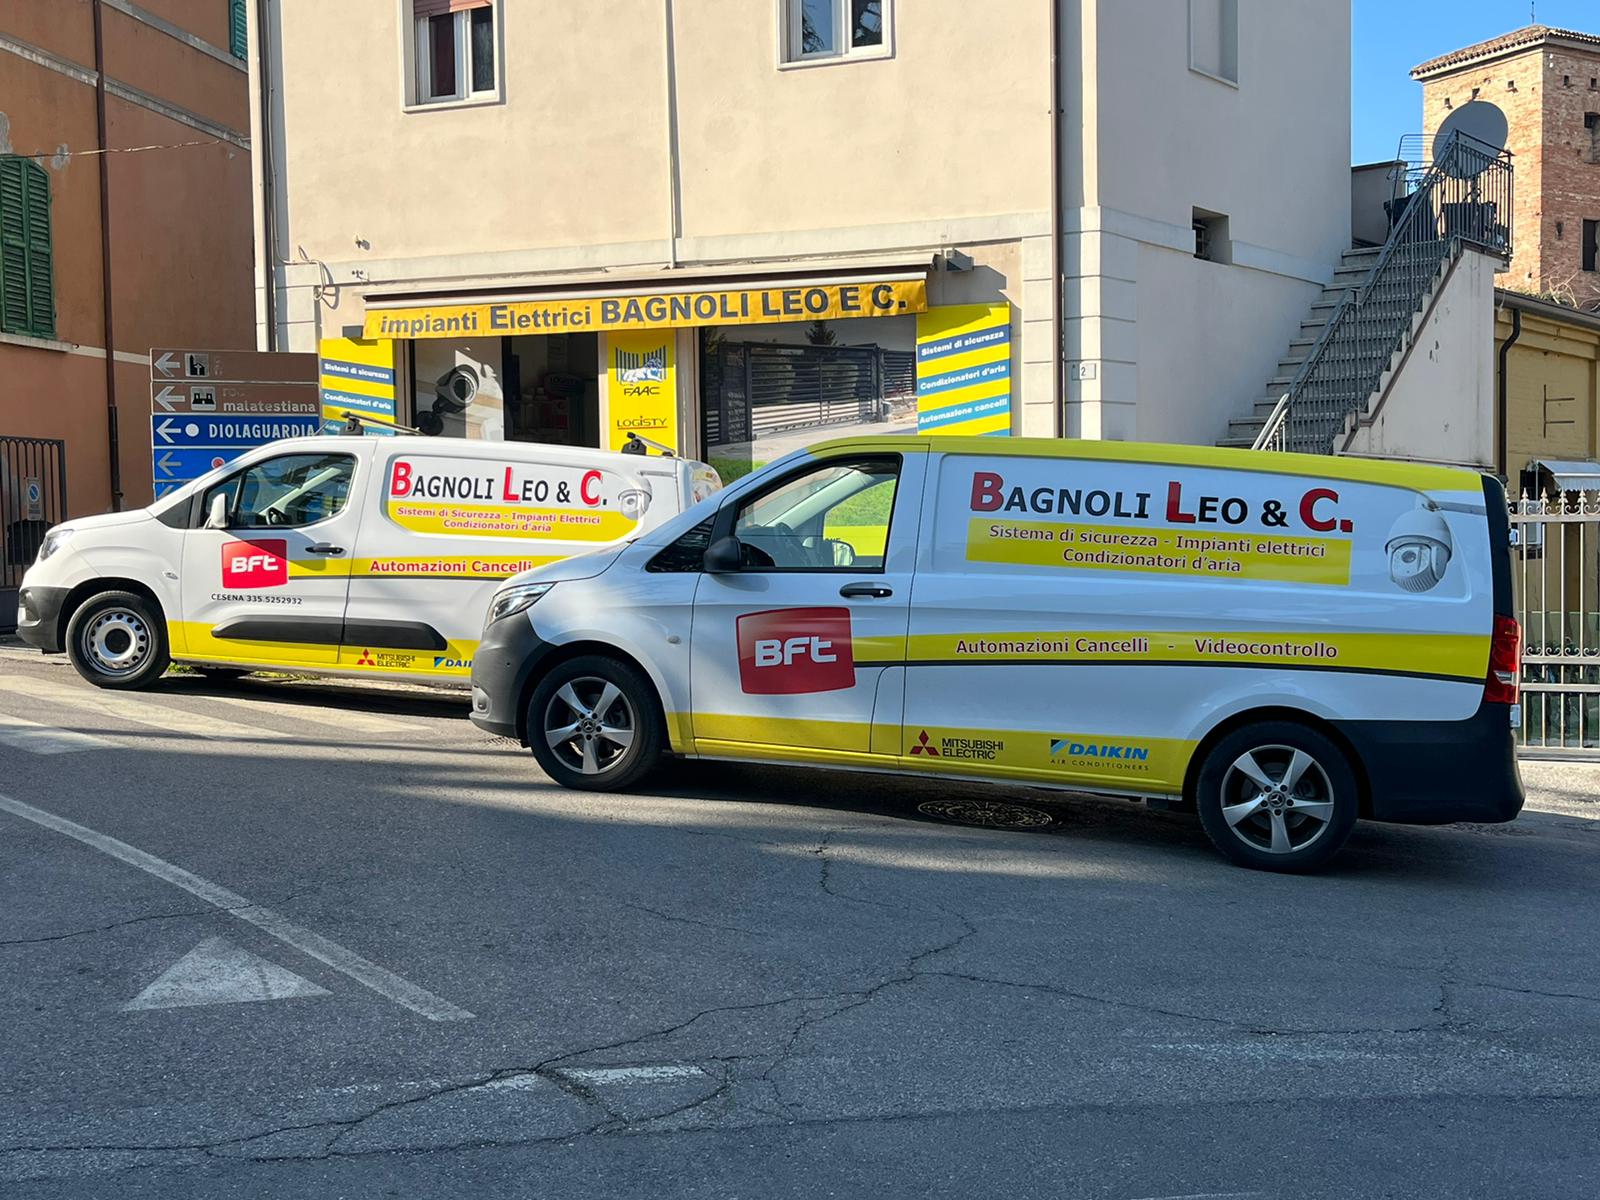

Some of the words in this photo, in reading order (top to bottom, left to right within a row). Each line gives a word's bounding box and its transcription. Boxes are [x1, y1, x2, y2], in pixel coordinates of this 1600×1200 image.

[381, 311, 477, 337] impianti
[490, 305, 591, 330] Elettrici
[601, 292, 749, 324] BAGNOLI
[762, 288, 829, 316] LEO
[840, 286, 861, 311] E
[872, 284, 907, 309] C.
[921, 342, 952, 356] Sistemi
[954, 339, 962, 349] di
[964, 330, 1005, 346] sicurezza
[920, 369, 980, 390] Condizionatori
[982, 364, 1006, 376] d'aria
[1080, 366, 1086, 377] 2
[624, 386, 660, 397] FAAC
[223, 401, 316, 412] malatestiana
[919, 406, 973, 425] Automazione
[974, 398, 1008, 412] cancelli
[209, 423, 315, 438] DIOLAGUARDIA
[390, 461, 495, 500] BAGNOLI
[503, 467, 549, 503] LEO
[556, 481, 571, 503] &
[580, 469, 608, 507] C.
[970, 471, 1151, 519] BAGNOLI
[1165, 481, 1248, 525] LEO
[1260, 500, 1289, 528] &
[1299, 487, 1354, 533] C.
[397, 507, 436, 518] Sistemi
[438, 508, 449, 518] di
[451, 509, 502, 520] Sicurezza
[511, 512, 557, 523] Impianti
[559, 514, 601, 525] Elettrici
[443, 519, 518, 531] Condizionatori
[521, 522, 552, 532] d'aria
[989, 525, 1054, 541] Sistema
[1059, 528, 1074, 542] di
[1079, 529, 1157, 547] sicurezza
[1176, 535, 1251, 553] Impianti
[1256, 541, 1326, 558] elettrici
[370, 560, 467, 573] Automazioni
[471, 560, 532, 573] Cancelli
[1063, 548, 1187, 569] Condizionatori
[211, 593, 245, 602] CESENA
[956, 637, 1070, 654] Automazioni
[1075, 637, 1149, 653] Cancelli
[1194, 638, 1338, 659] Videocontrollo
[941, 738, 1004, 751] MITSUBISHI
[1068, 743, 1149, 761] DAIKIN
[942, 748, 996, 760] ELECTRIC
[1072, 760, 1149, 771] CONDITIONERS
